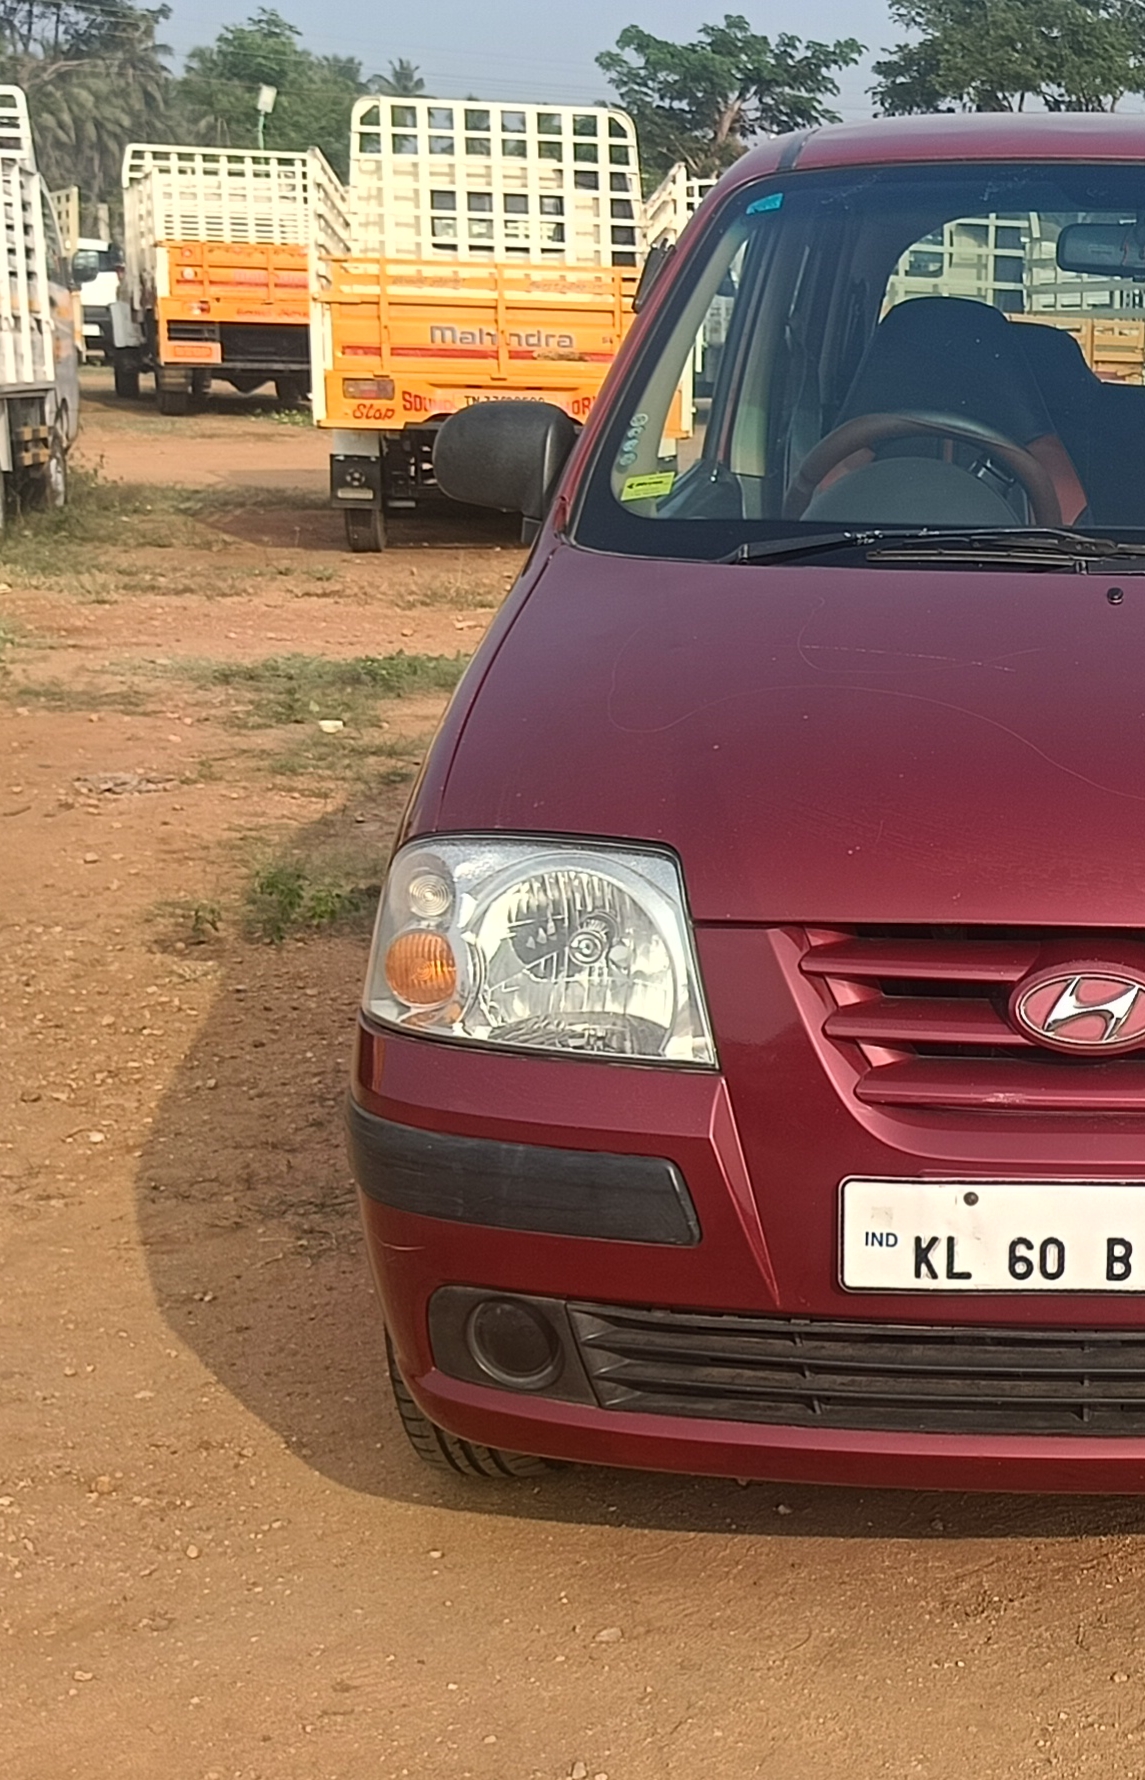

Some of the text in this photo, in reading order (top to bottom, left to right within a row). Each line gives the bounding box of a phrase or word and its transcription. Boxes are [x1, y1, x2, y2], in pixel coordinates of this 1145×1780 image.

[429, 325, 574, 349] Mahndra
[865, 1231, 898, 1248] IND
[914, 1235, 973, 1280] KL
[1008, 1236, 1066, 1281] 60
[1105, 1237, 1133, 1282] B
